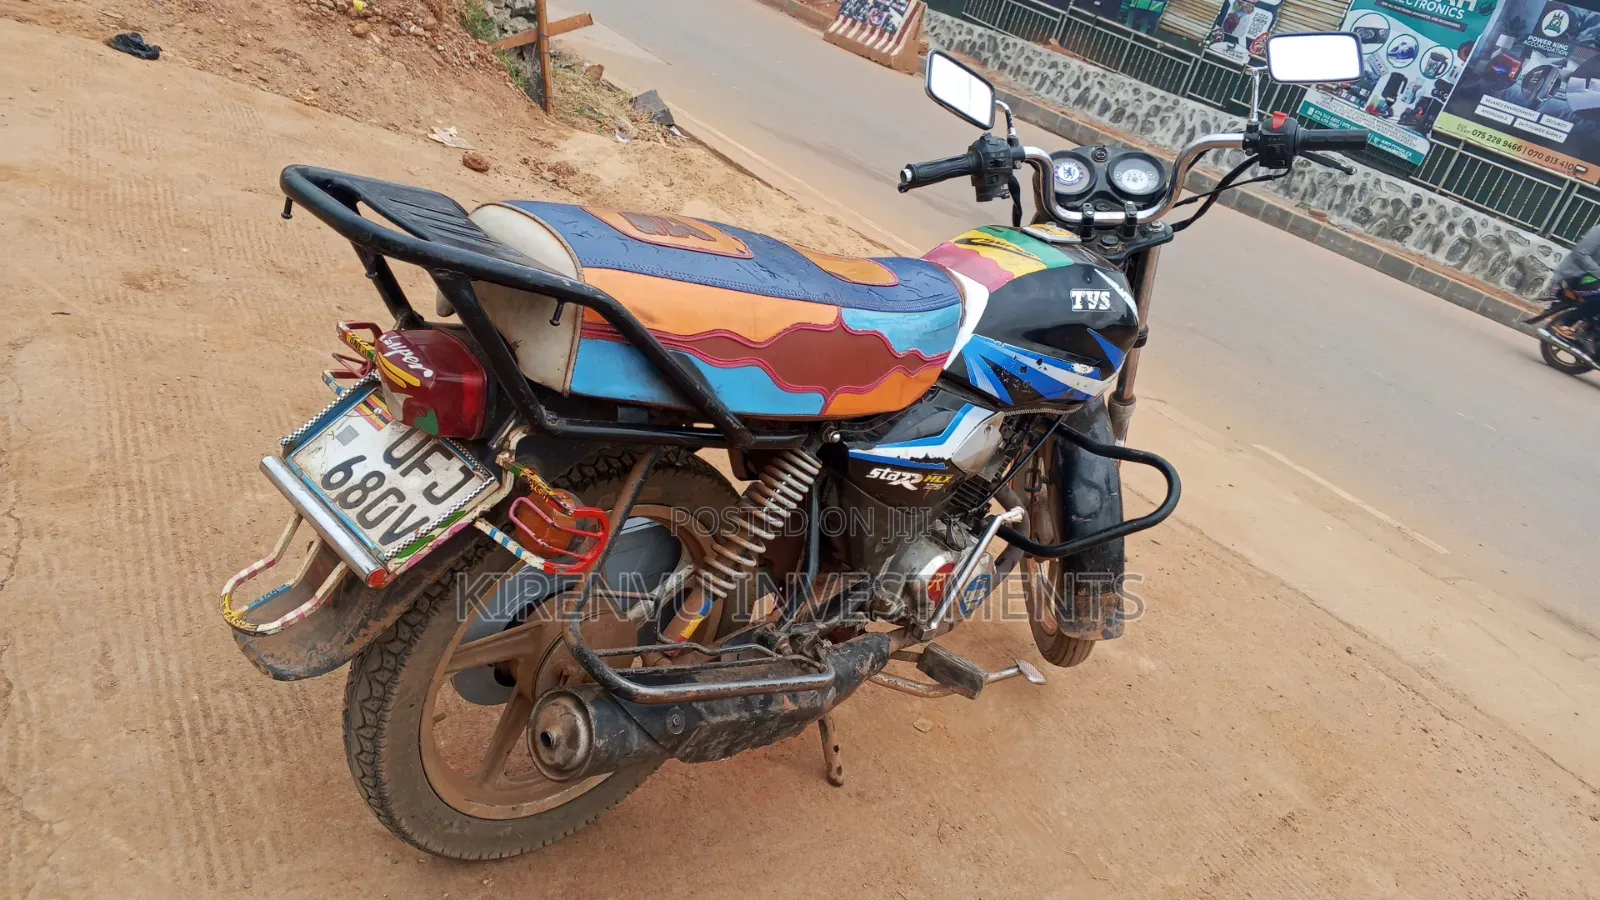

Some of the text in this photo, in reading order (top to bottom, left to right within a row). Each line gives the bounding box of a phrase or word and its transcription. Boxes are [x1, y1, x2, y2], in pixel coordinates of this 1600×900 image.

[1523, 40, 1568, 56] ACCOMODATION
[1528, 35, 1569, 50] POWER KING
[1504, 103, 1535, 117] ENVIRONMENT
[1546, 118, 1567, 129] SECURITY
[1528, 124, 1545, 133] POWER
[1545, 130, 1562, 139] SUPPLY
[1471, 129, 1486, 139] 075
[1486, 134, 1501, 145] 228
[1502, 140, 1522, 152] 9466
[1527, 149, 1543, 159] 070
[1544, 154, 1558, 164] 813
[1071, 290, 1111, 311] TVS
[383, 427, 475, 505] UFJ
[922, 473, 954, 484] HLX
